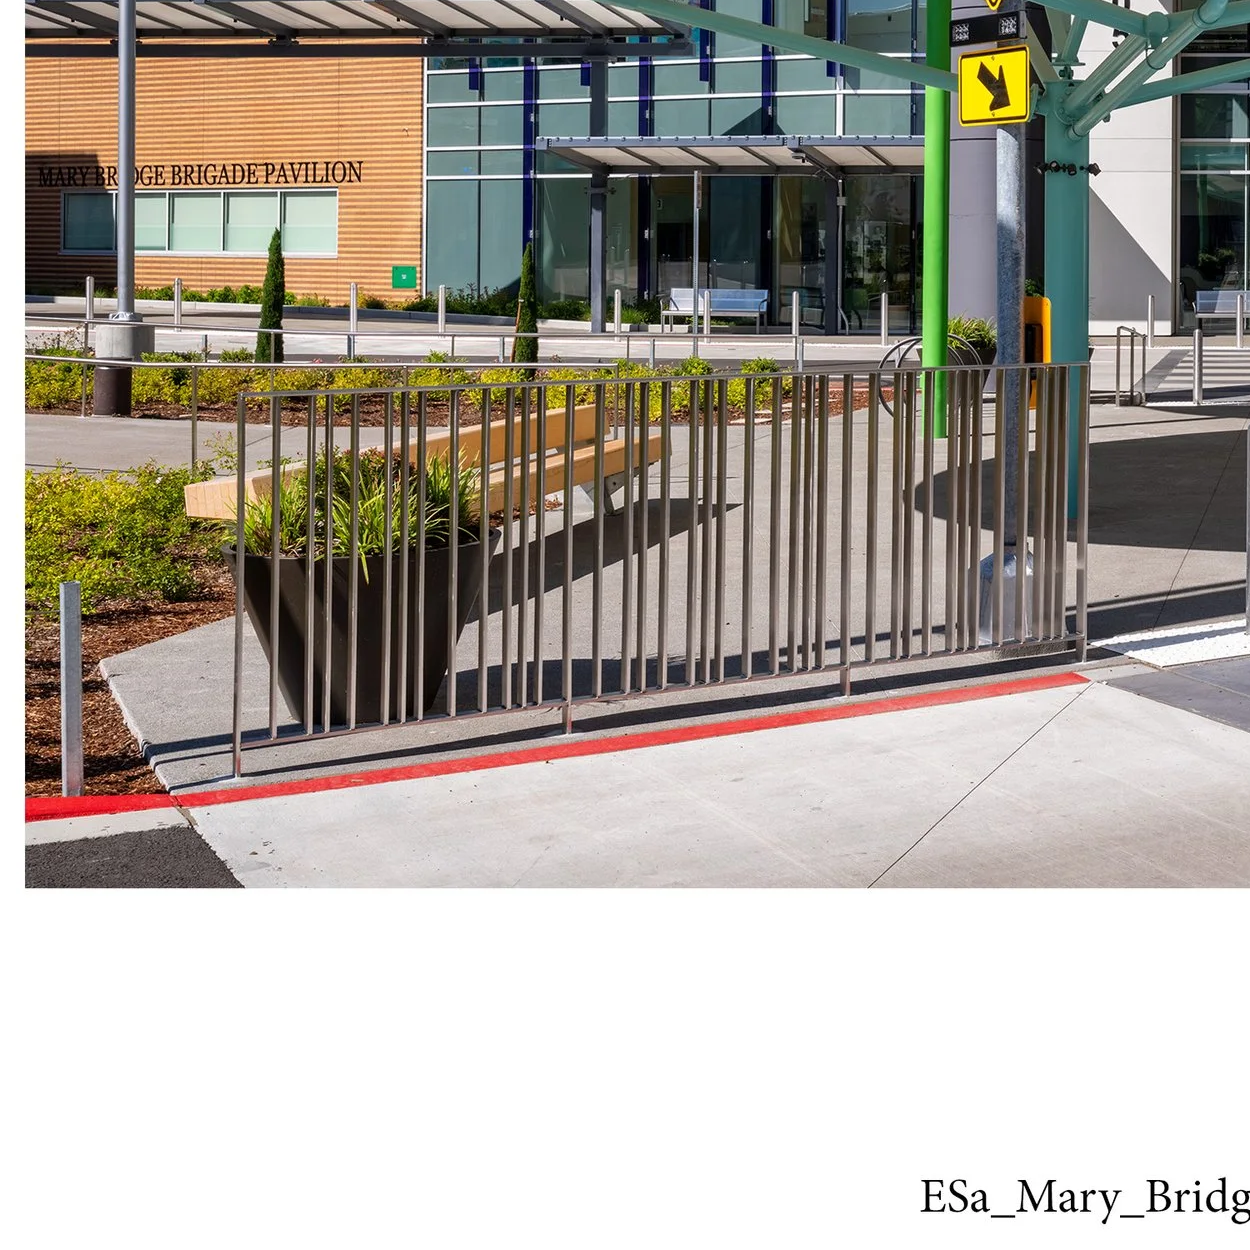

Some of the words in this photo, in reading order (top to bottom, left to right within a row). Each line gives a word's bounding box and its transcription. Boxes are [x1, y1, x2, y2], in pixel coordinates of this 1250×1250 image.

[38, 165, 91, 187] MARY
[95, 165, 166, 187] BRGE
[170, 162, 260, 186] BRIGADE
[263, 160, 364, 184] PAVILION
